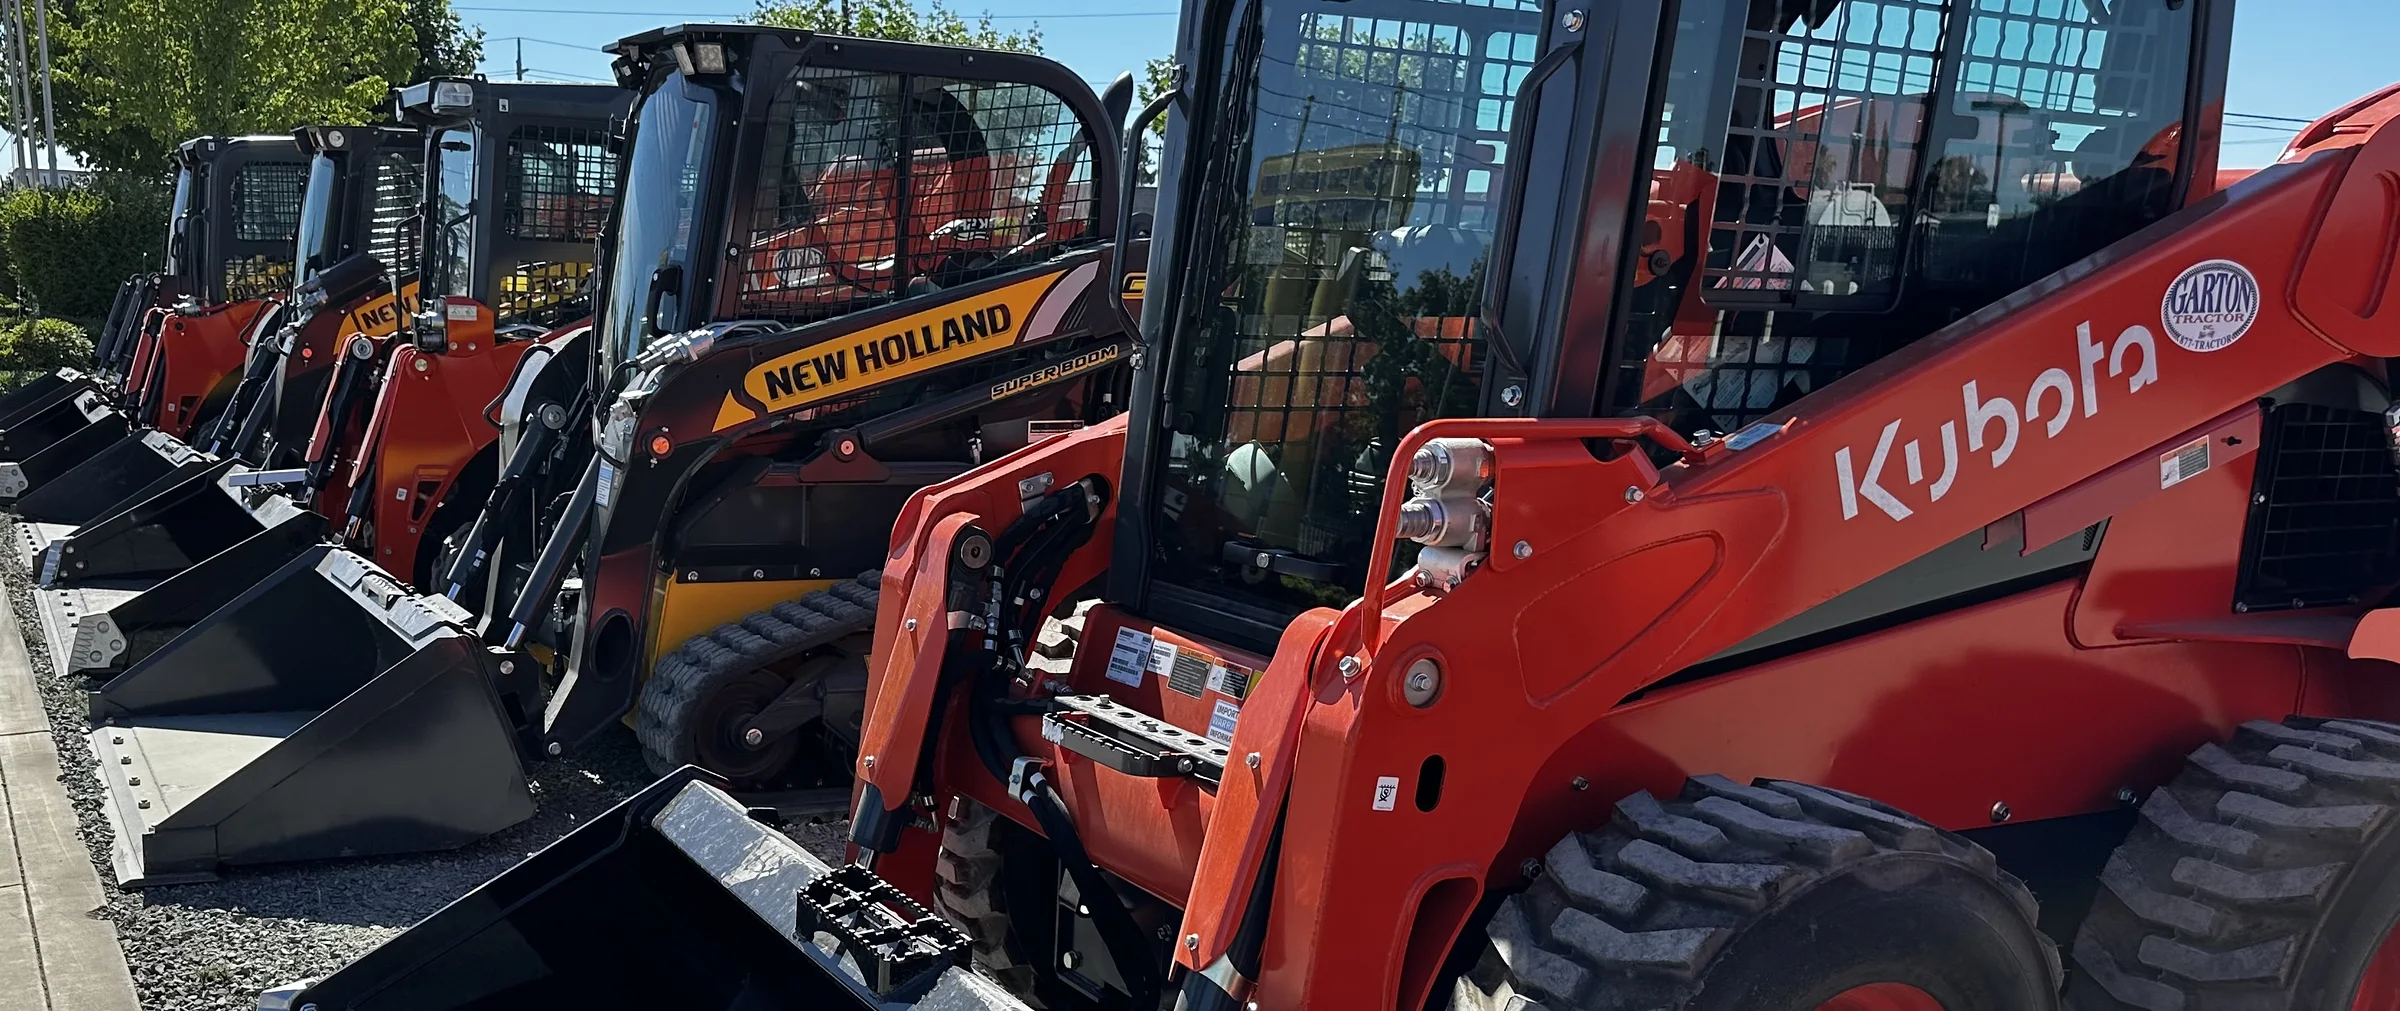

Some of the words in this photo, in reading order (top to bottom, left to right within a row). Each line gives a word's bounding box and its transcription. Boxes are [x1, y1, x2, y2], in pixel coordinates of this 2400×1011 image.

[2170, 272, 2252, 315] GARTON
[2173, 313, 2245, 324] TRACTOR
[764, 349, 847, 401] NEW
[854, 303, 1013, 375] HOLLAND
[991, 364, 1058, 400] SUPER
[1058, 344, 1118, 376] BOOM
[1834, 320, 2158, 521] Kubota
